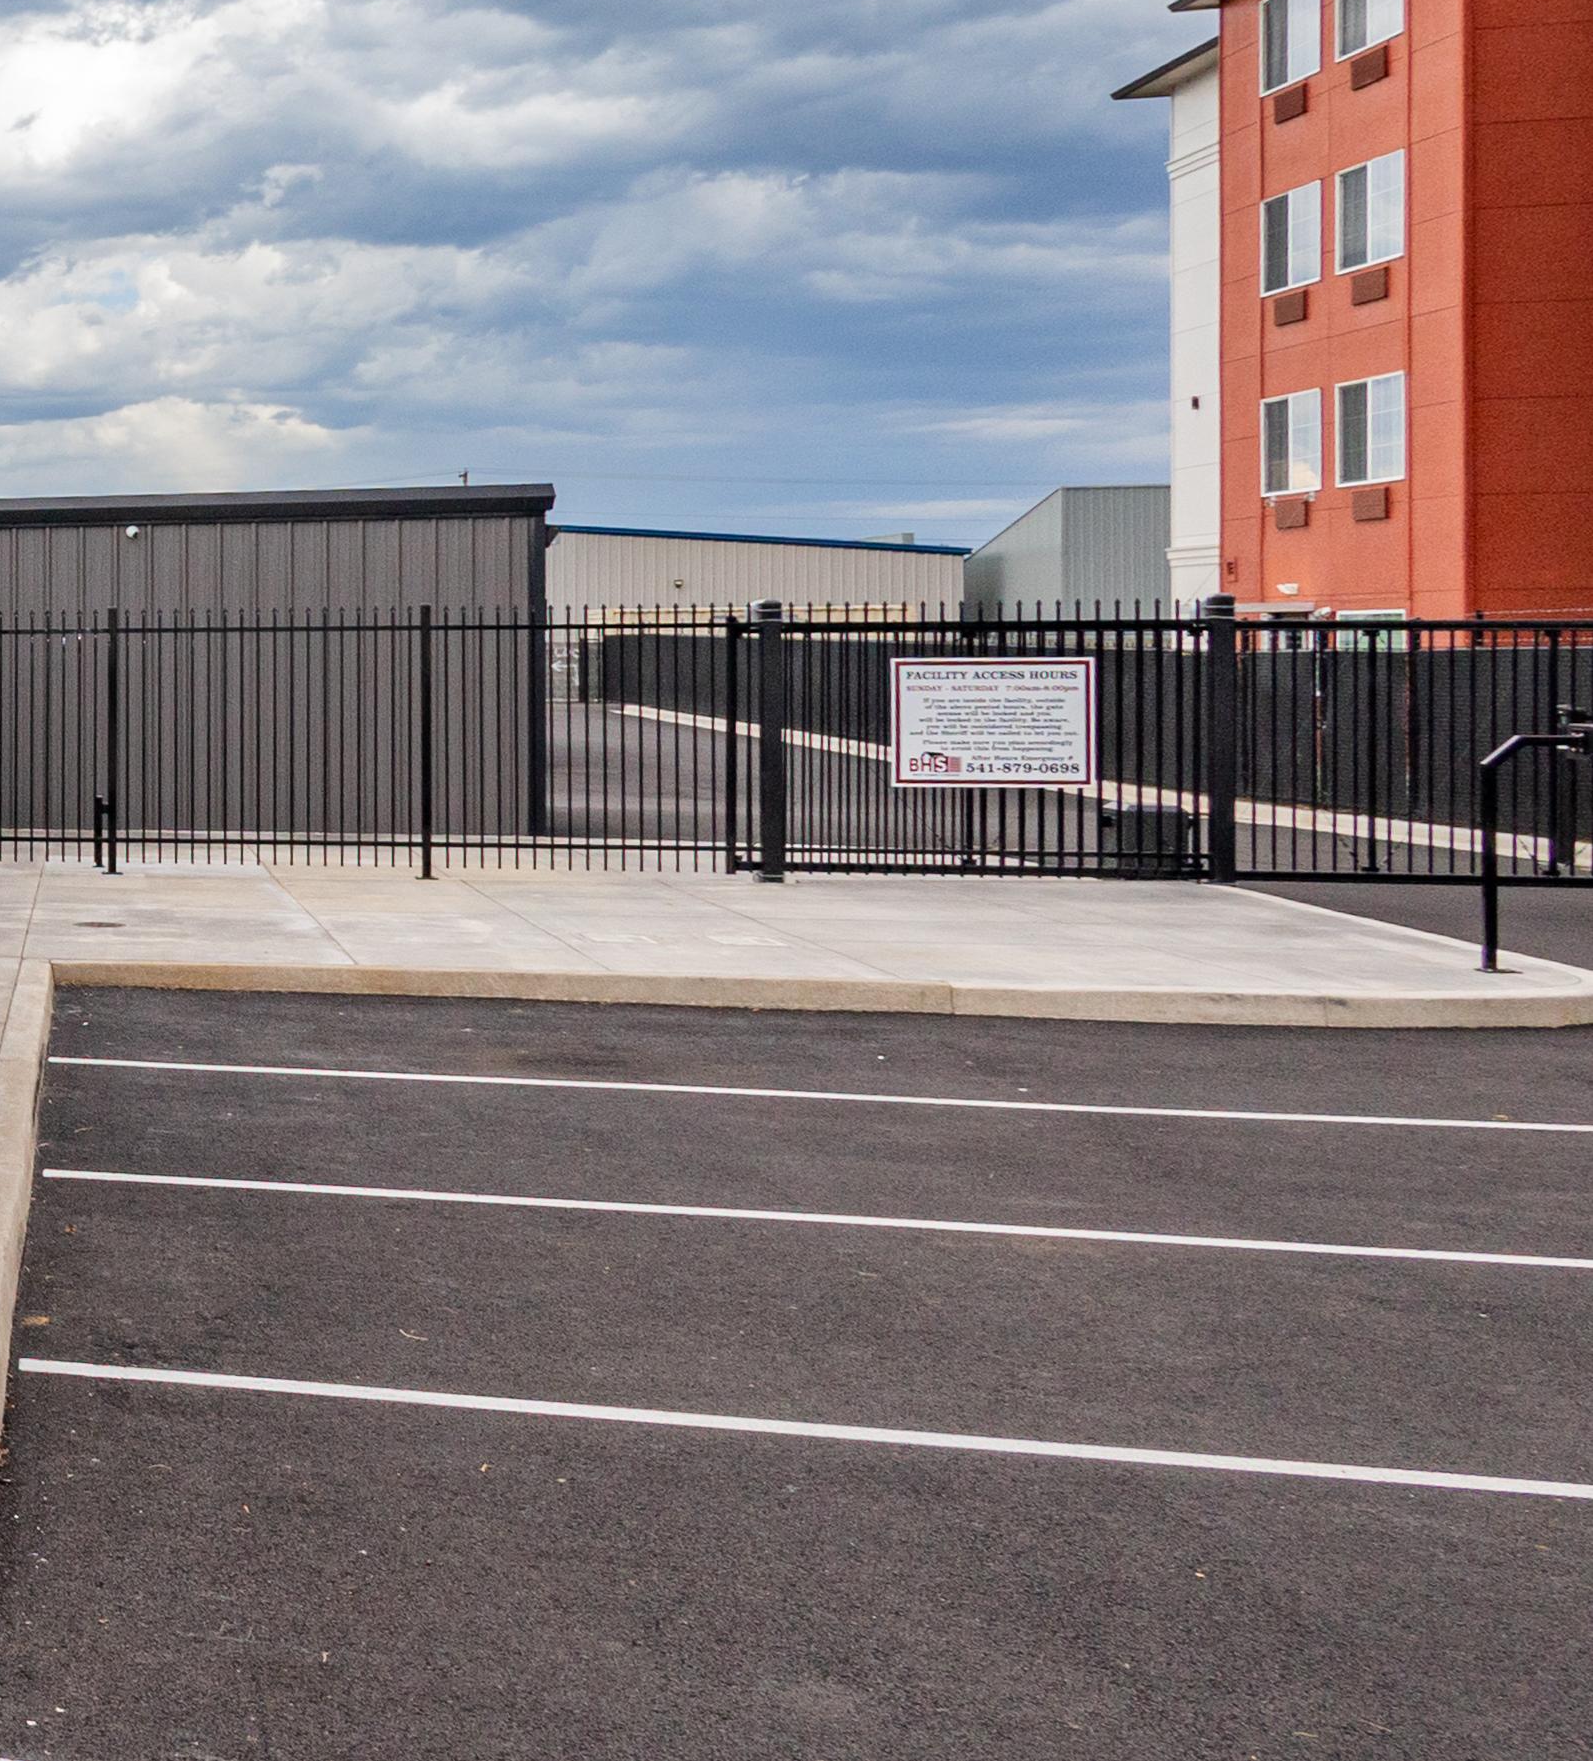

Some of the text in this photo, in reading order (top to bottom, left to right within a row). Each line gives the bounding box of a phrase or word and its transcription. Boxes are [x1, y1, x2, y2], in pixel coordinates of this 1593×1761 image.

[906, 671, 1078, 680] FACILITY ACCESS HOURS
[909, 752, 949, 772] BHS
[966, 763, 1080, 773] 541-879-0698
